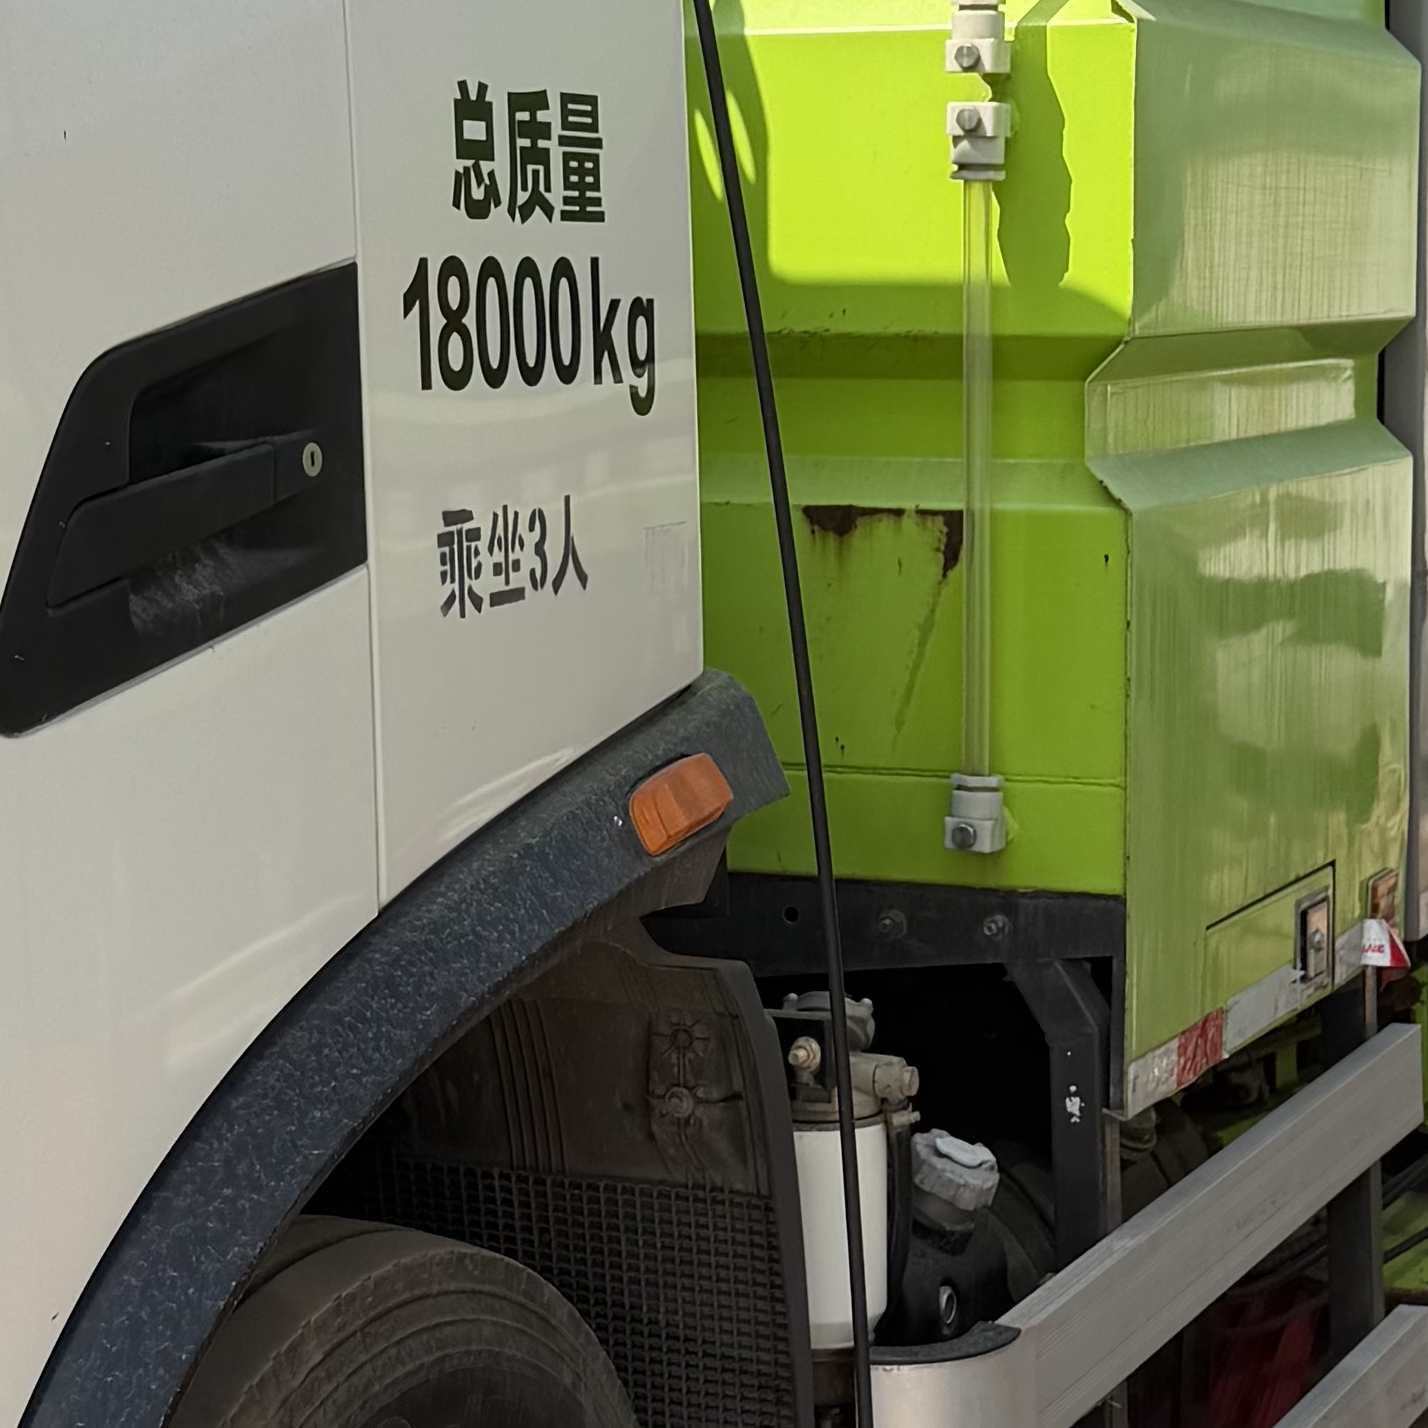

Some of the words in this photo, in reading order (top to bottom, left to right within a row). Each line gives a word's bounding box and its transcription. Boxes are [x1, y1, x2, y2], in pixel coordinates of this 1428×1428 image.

[452, 79, 606, 225] 总质量
[402, 254, 656, 416] 18000kg
[436, 494, 589, 619] 乘坐3人
